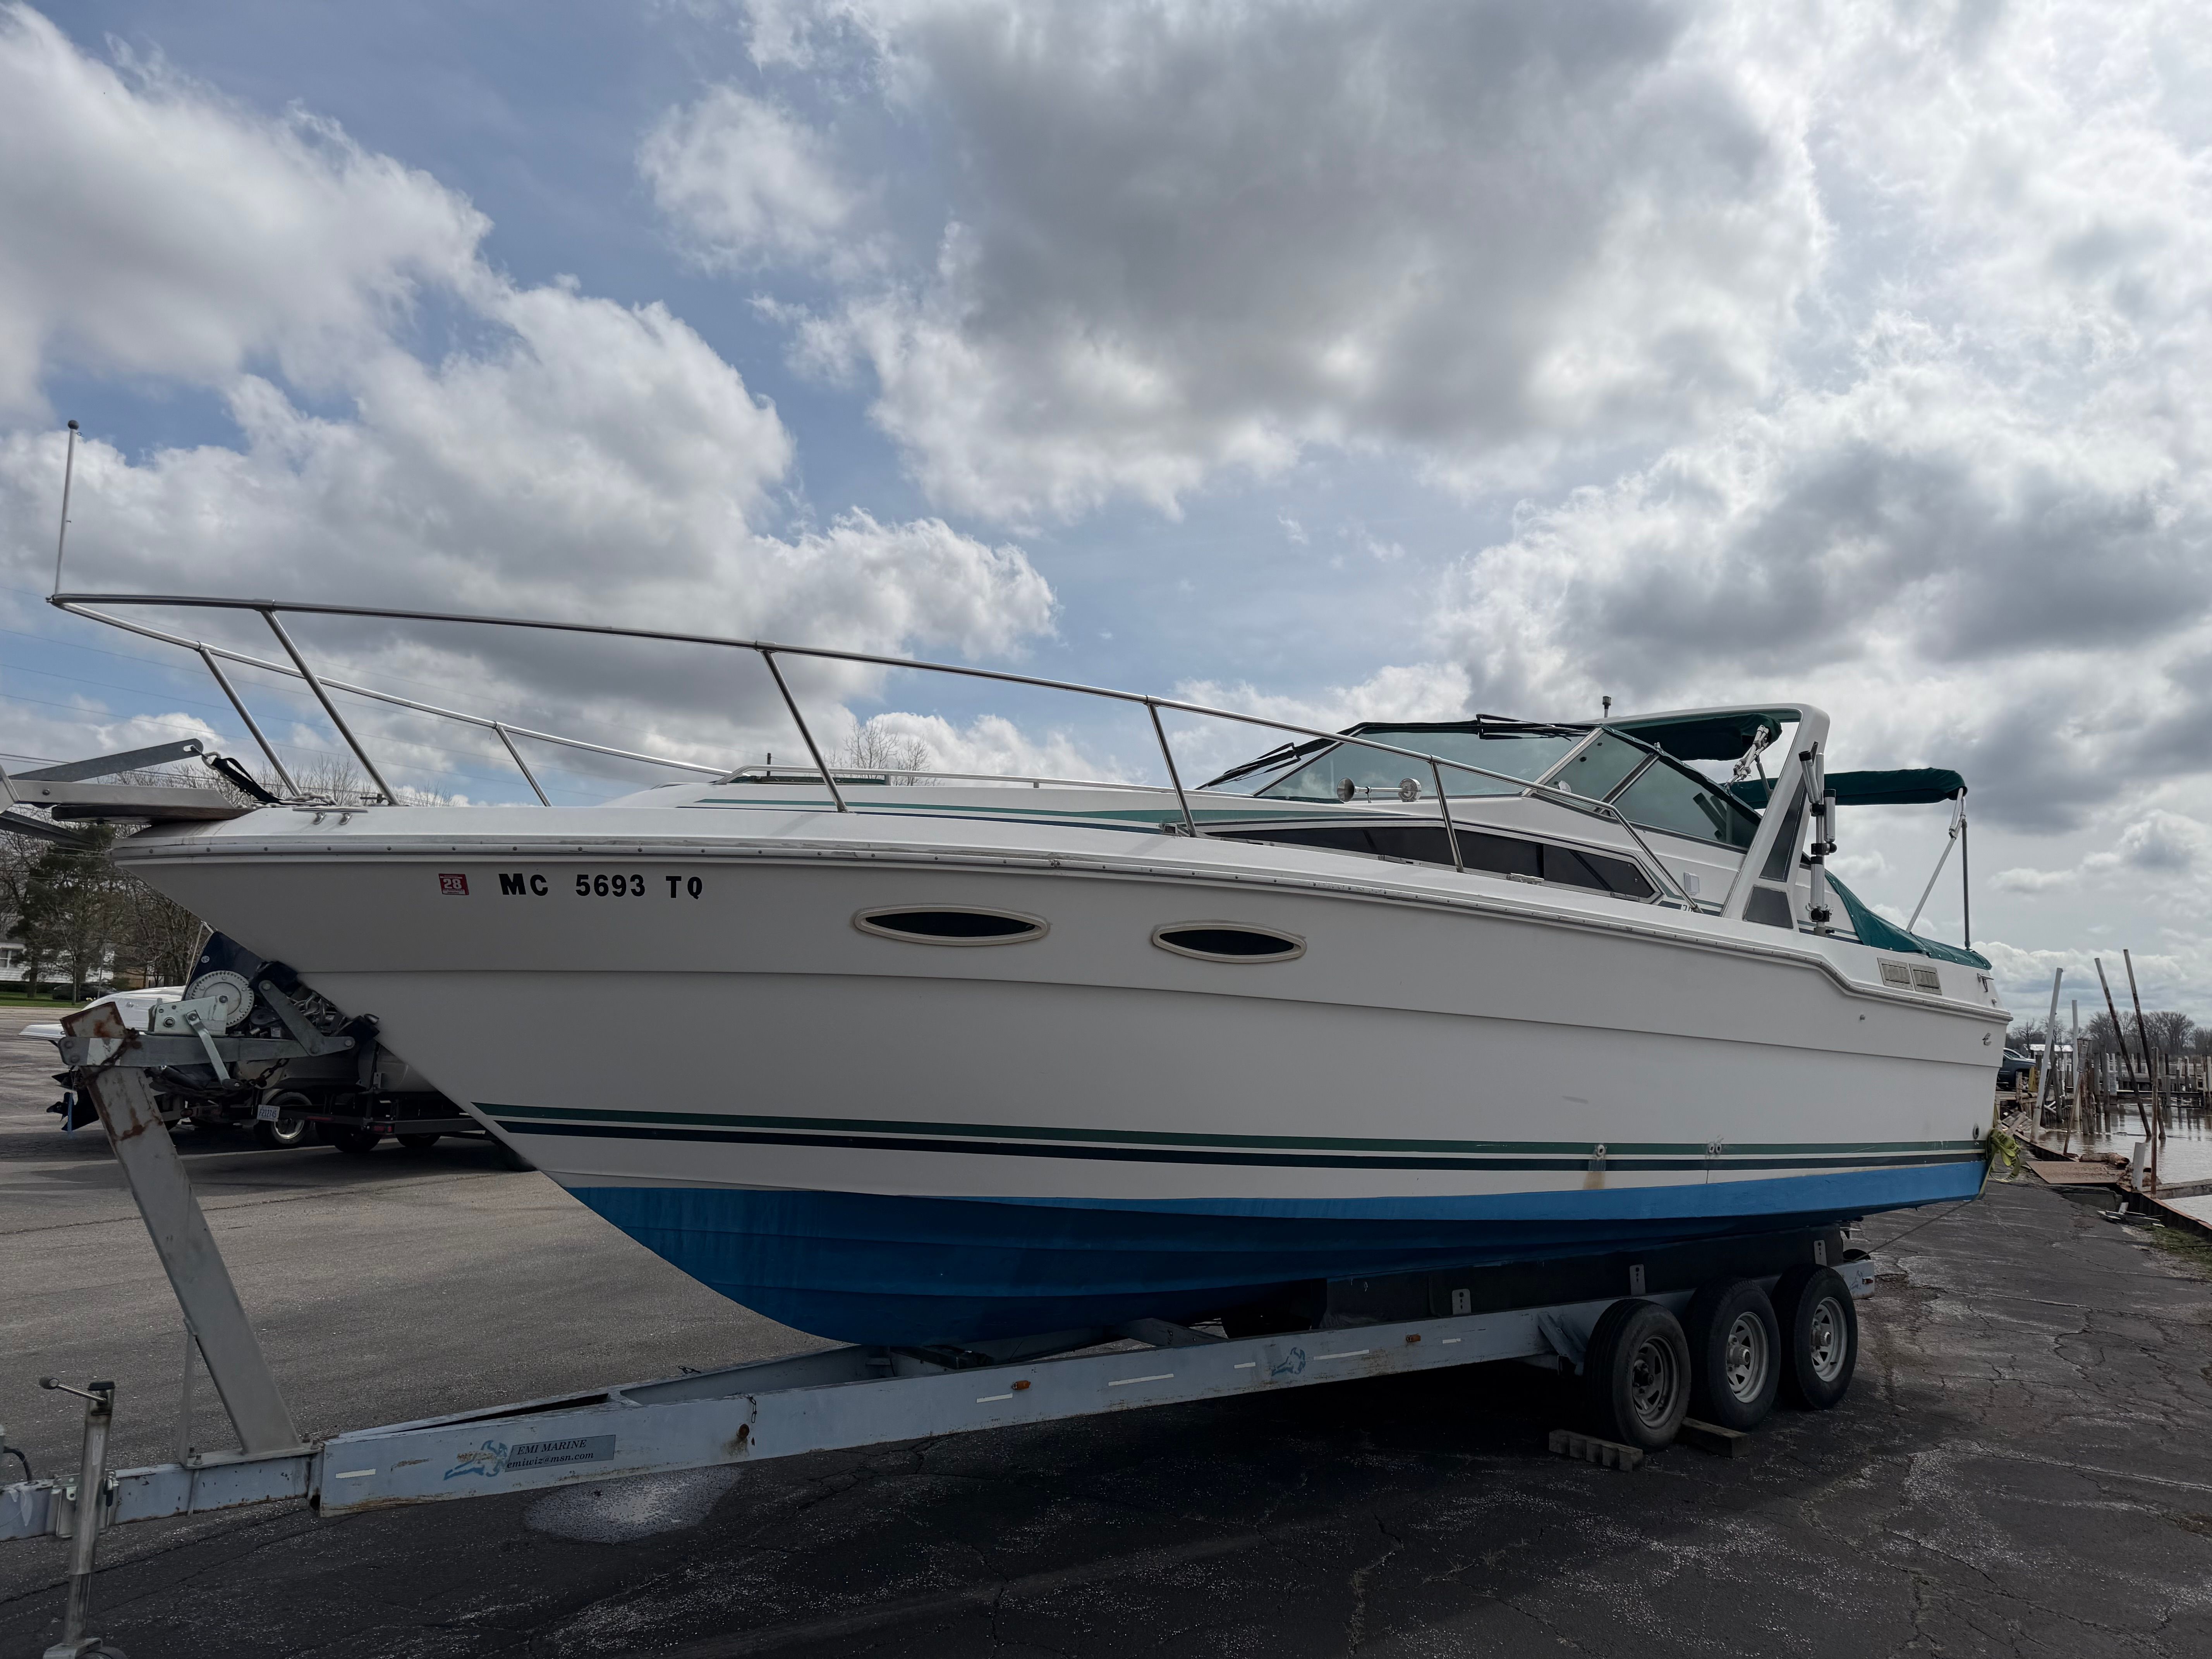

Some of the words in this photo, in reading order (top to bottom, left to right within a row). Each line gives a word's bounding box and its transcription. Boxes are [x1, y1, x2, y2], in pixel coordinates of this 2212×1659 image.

[443, 878, 462, 889] 28
[499, 873, 548, 896] MC
[575, 874, 646, 897] 5693
[666, 876, 703, 900] TQ
[517, 1445, 538, 1455] EMI
[542, 1439, 587, 1453] MARINE
[507, 1452, 594, 1468] emiwiz@msn.com
